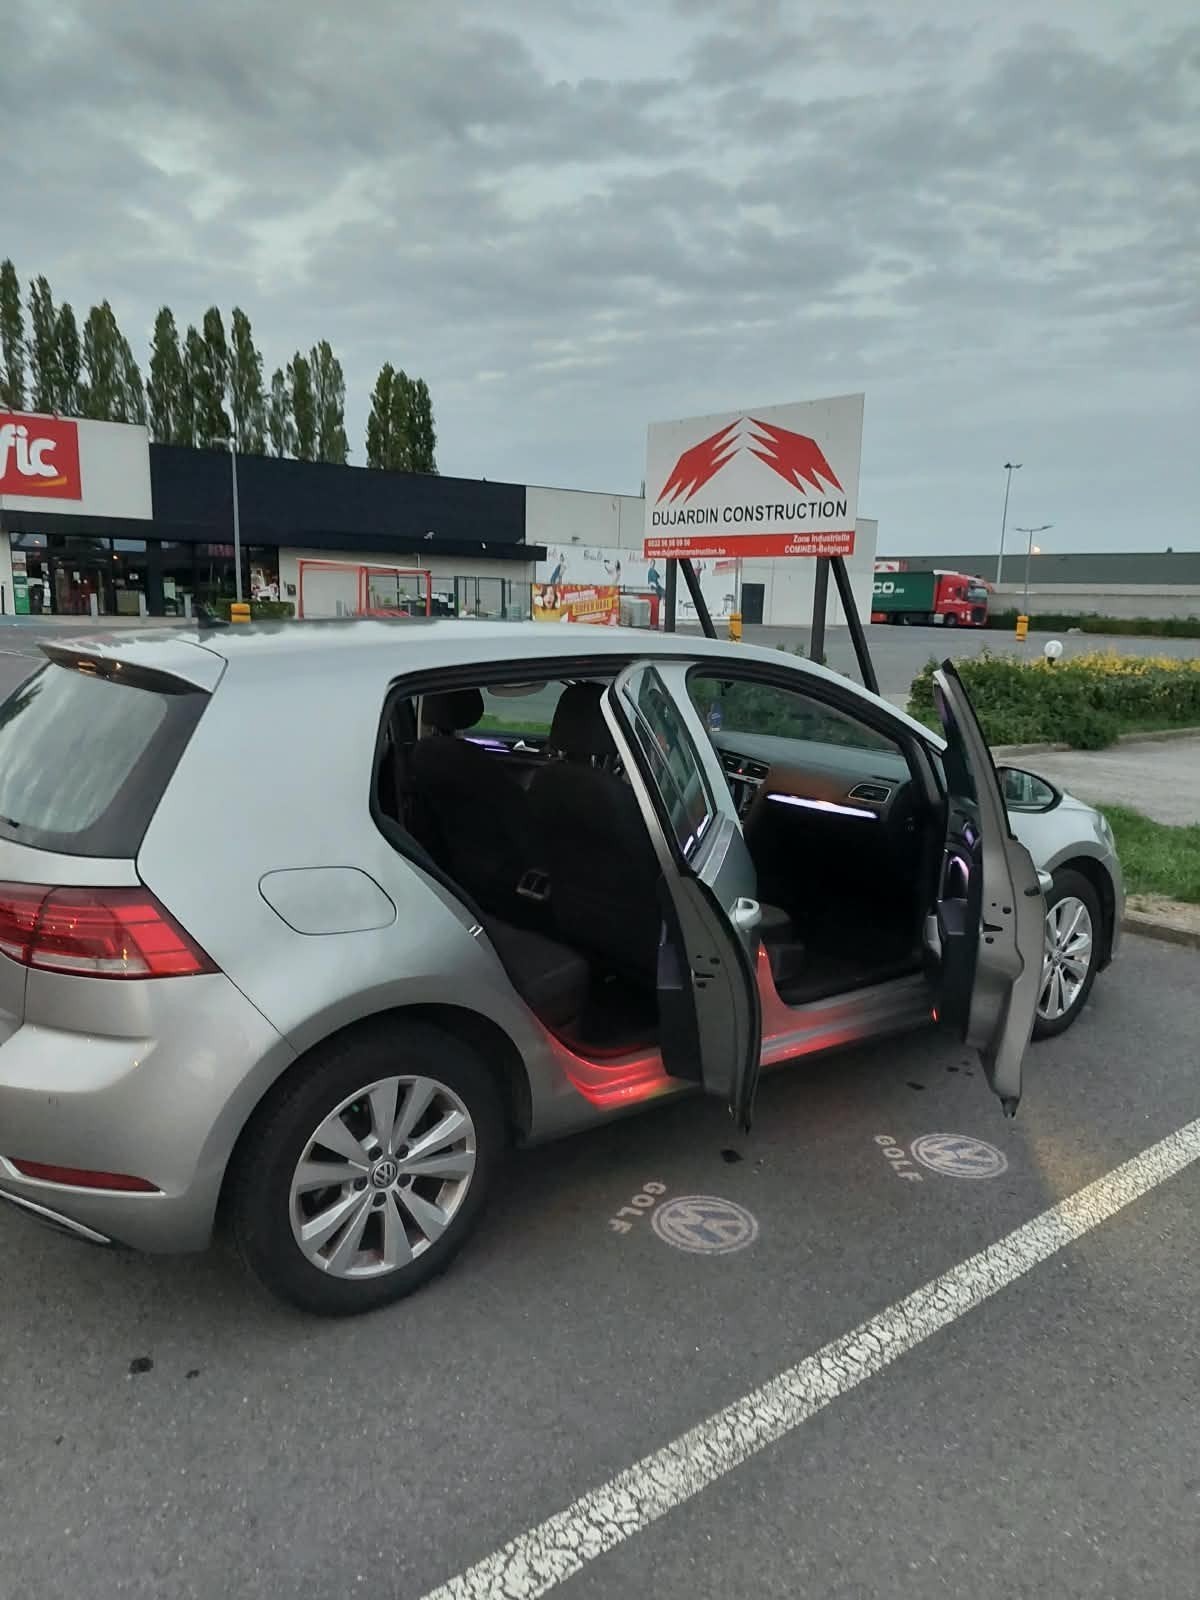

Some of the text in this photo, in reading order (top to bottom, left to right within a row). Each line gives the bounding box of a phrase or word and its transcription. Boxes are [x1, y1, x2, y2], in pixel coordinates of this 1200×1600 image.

[652, 500, 847, 526] DUJARDIN CONSTRUCTION
[874, 1135, 924, 1182] GOLF
[610, 1181, 666, 1235] GOLF
